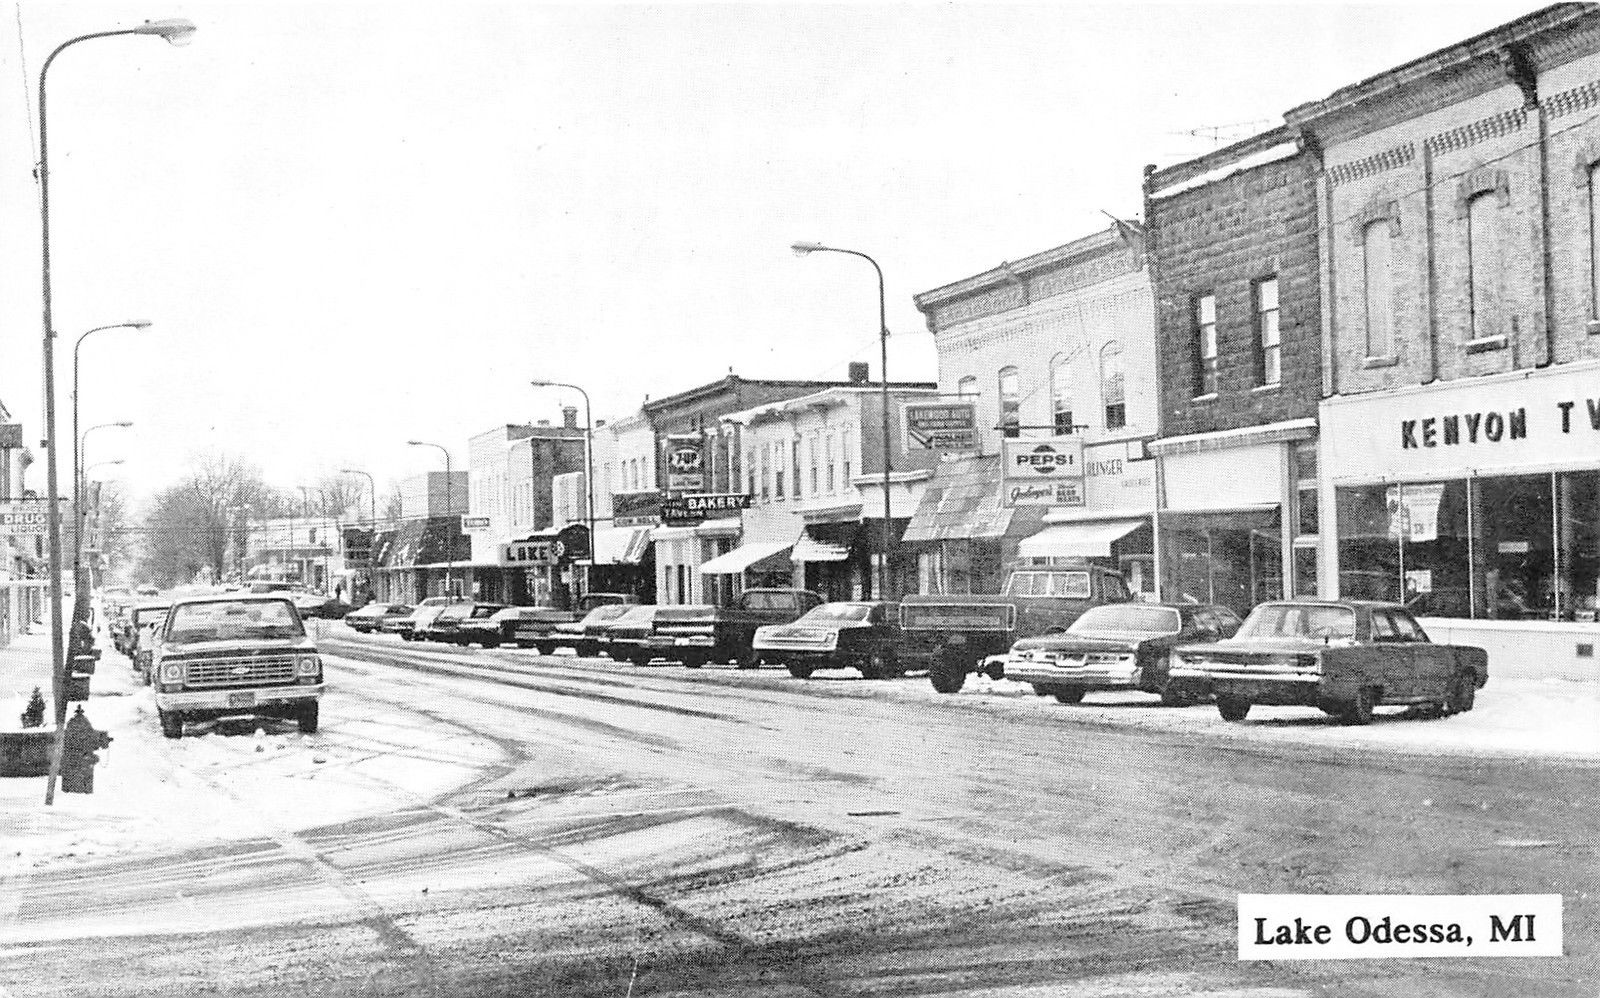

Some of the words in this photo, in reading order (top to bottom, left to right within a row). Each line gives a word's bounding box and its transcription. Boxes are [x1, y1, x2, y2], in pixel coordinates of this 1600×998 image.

[1401, 407, 1527, 450] KENYON
[1016, 454, 1074, 466] PEPSI
[687, 496, 745, 510] BAKERY
[506, 546, 548, 561] LAKE
